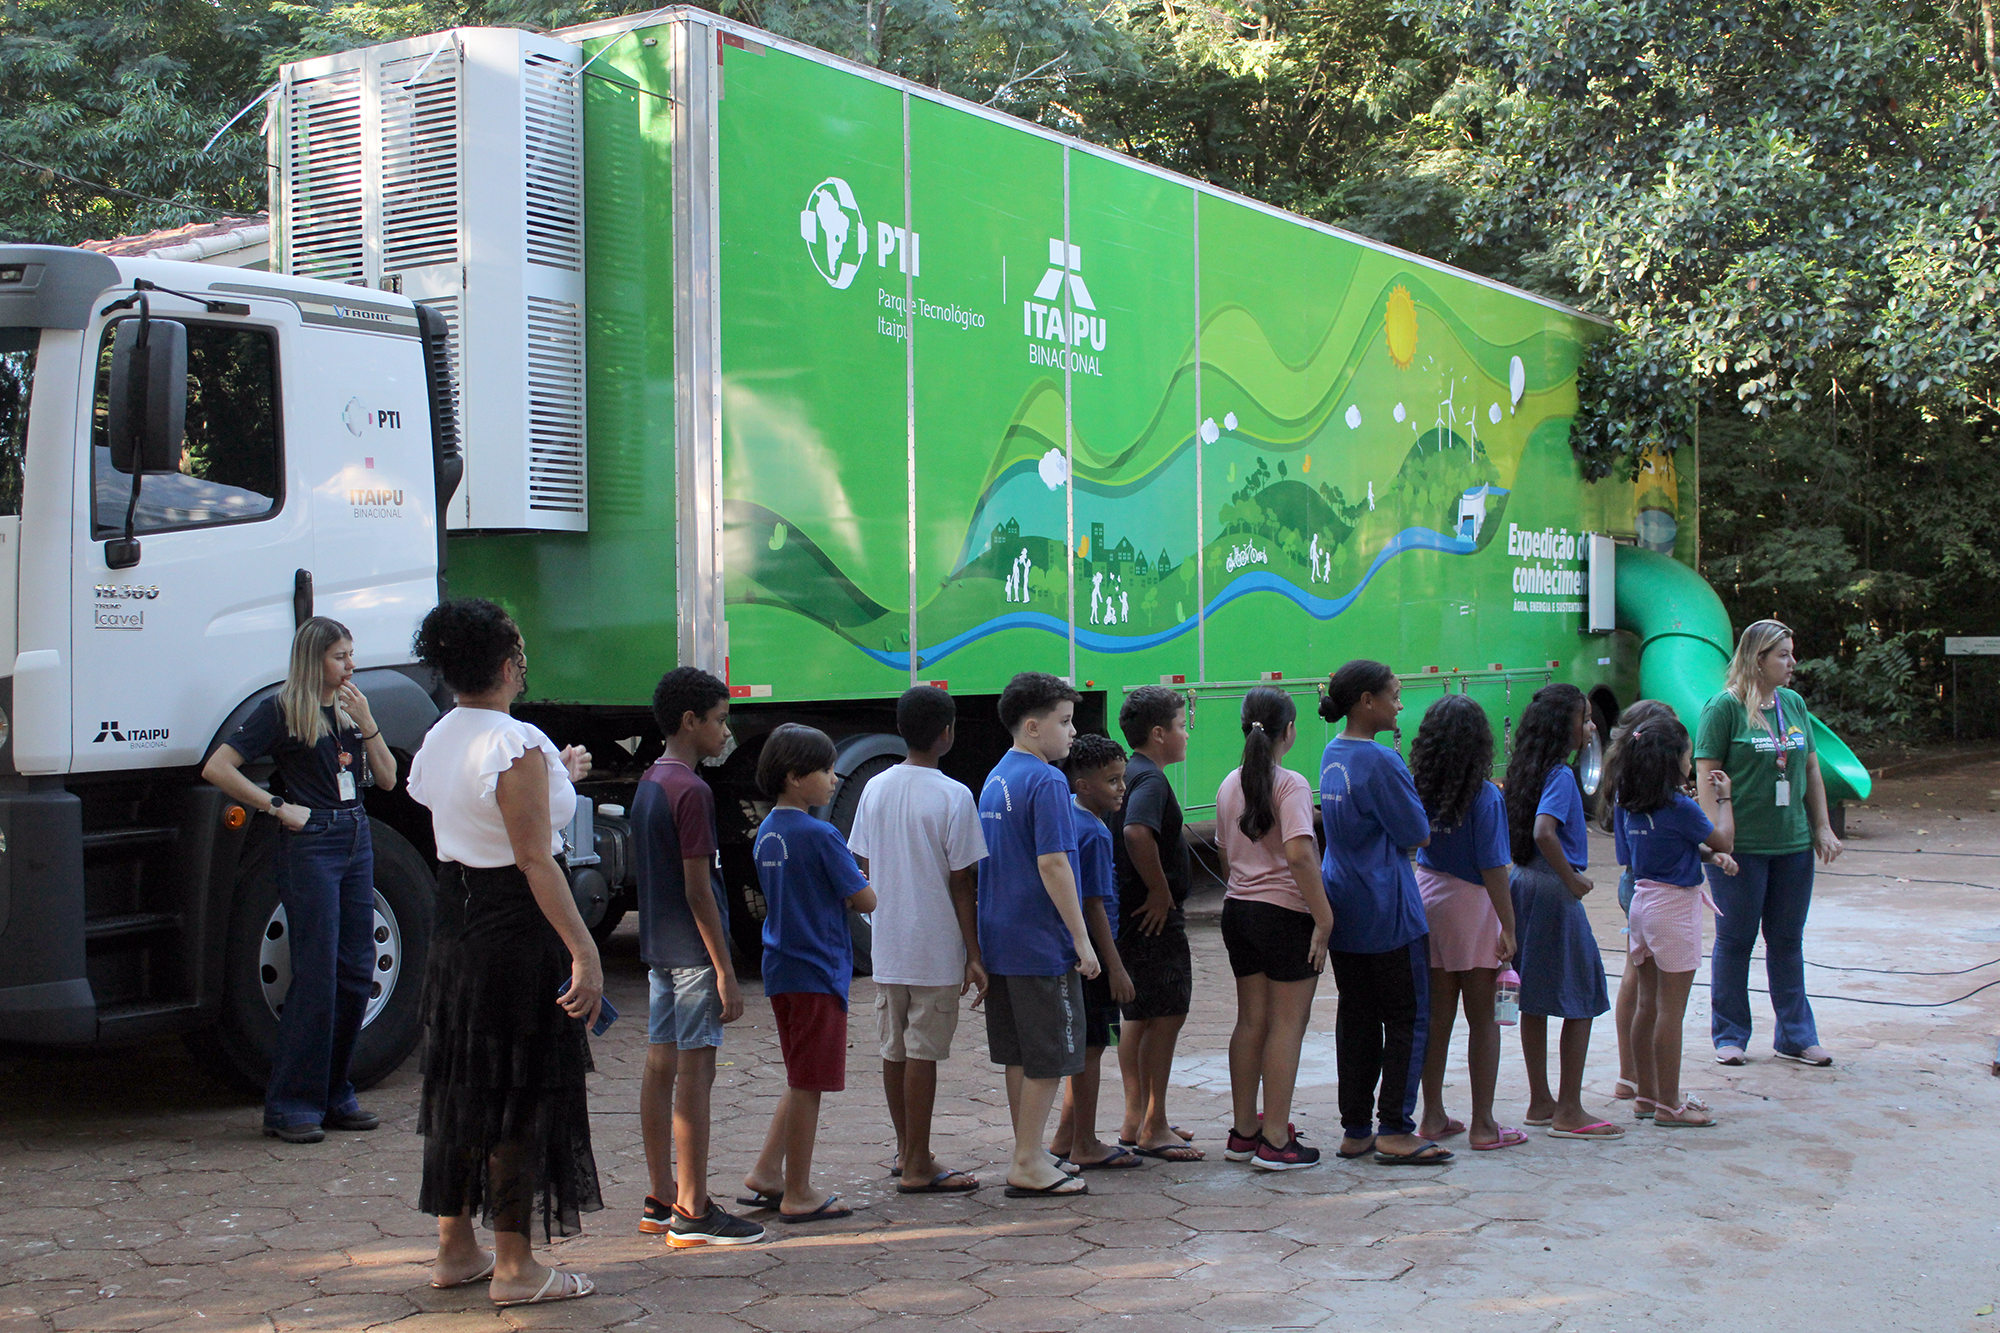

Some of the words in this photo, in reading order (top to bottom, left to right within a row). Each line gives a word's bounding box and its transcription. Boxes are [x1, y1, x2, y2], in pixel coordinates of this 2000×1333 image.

[877, 221, 920, 277] PTI
[878, 287, 917, 317] Parque
[918, 298, 985, 331] Tecnológico
[1029, 343, 1103, 377] BINACONAL
[378, 410, 401, 429] PTI
[350, 489, 403, 506] ITAIPU
[353, 508, 402, 519] BINACIONAL
[1508, 523, 1575, 567] Expedição
[1512, 561, 1588, 596] conhecimen
[127, 728, 169, 741] ITAIPU
[130, 741, 167, 749] BINACIONAL
[1061, 973, 1069, 998] RUL
[1064, 1000, 1075, 1054] BROKEN
